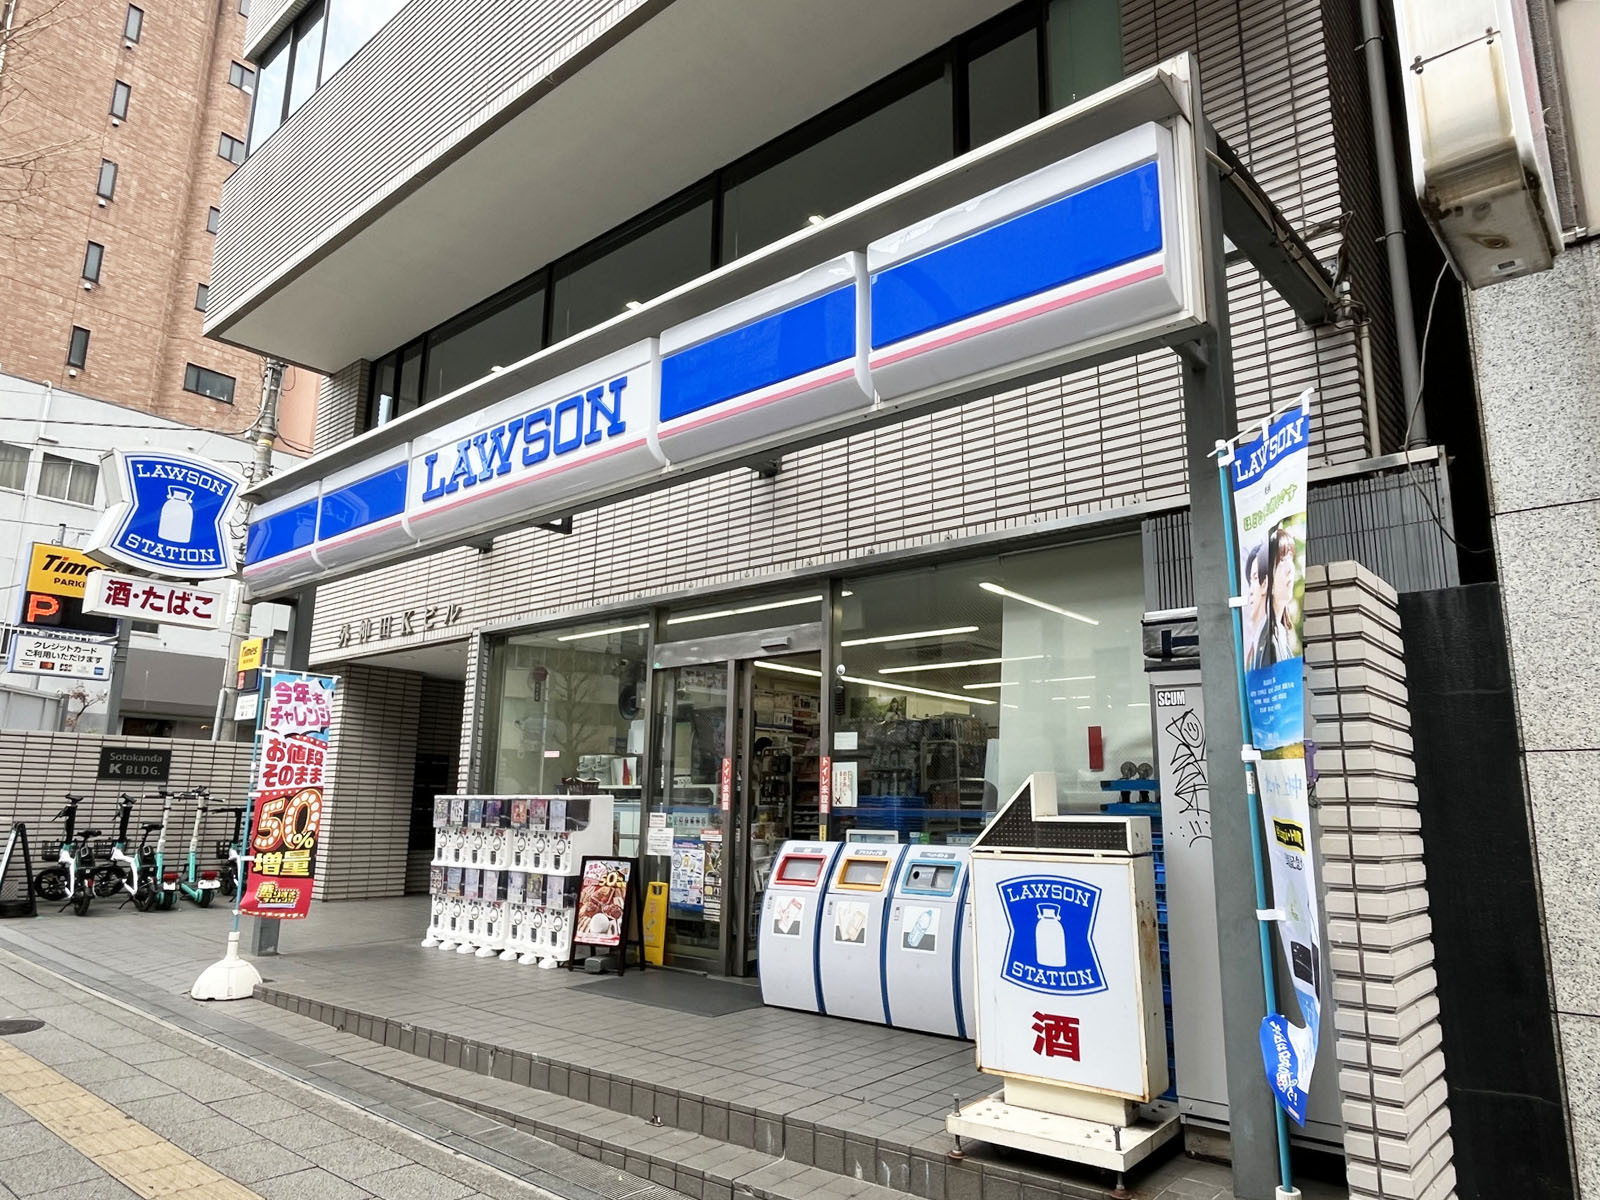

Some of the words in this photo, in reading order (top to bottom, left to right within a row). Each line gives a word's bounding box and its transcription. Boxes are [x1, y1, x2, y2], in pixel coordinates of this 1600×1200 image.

[424, 377, 626, 502] LAWSON
[136, 463, 227, 496] LAWSON
[125, 533, 216, 562] STATION
[42, 554, 116, 577] Tim
[54, 577, 85, 588] PARKI
[27, 593, 60, 623] P
[24, 648, 103, 664] ご利用いただけます
[33, 641, 98, 655] クレジットカード
[274, 682, 326, 705] 今年も
[1157, 690, 1186, 707] SCUM
[270, 705, 331, 727] チャレンジ
[110, 752, 163, 762] Sotokanda
[266, 738, 324, 767] お値段
[109, 763, 122, 774] K
[125, 765, 161, 776] BLDG.
[262, 763, 322, 788] そのまま
[252, 787, 322, 851] 50%
[253, 849, 311, 877] 増量
[1006, 883, 1091, 908] LAWSON
[1011, 960, 1095, 988] STATION
[1031, 1010, 1081, 1062] 酒
